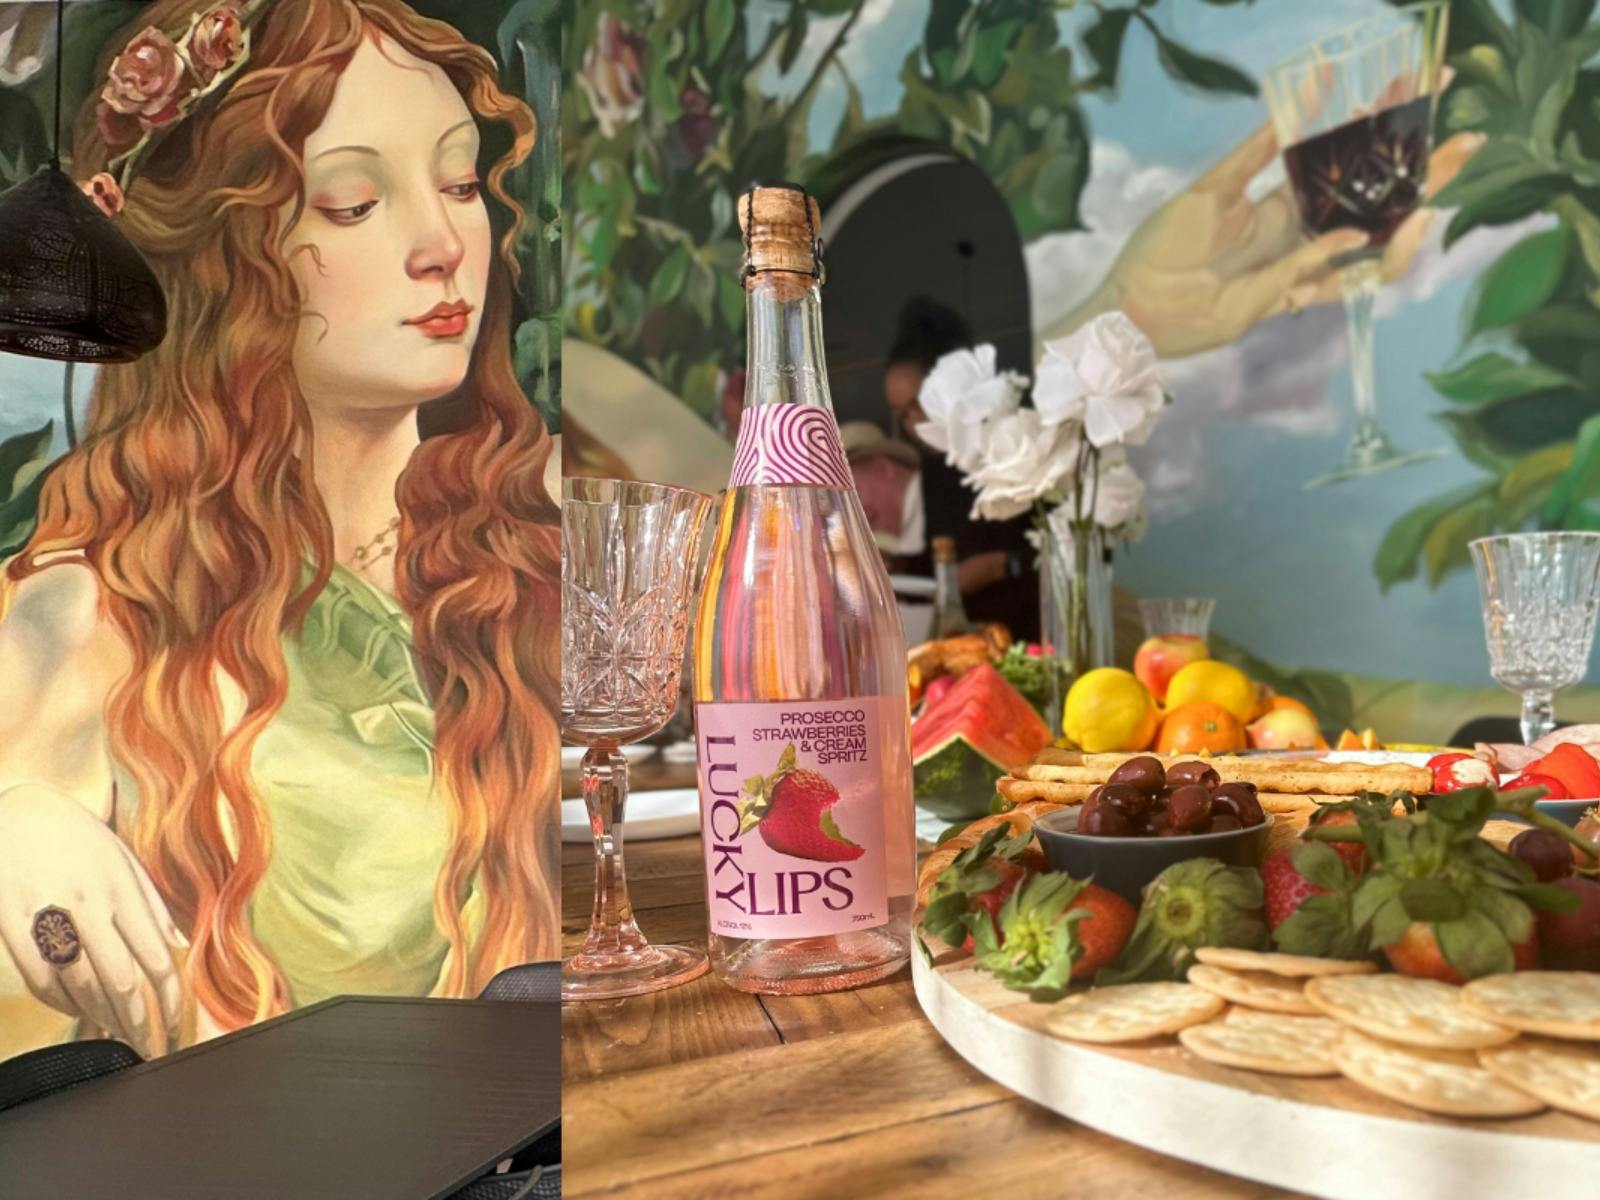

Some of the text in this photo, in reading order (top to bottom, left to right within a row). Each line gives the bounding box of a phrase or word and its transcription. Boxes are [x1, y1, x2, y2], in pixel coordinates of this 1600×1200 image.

[780, 709, 865, 725] PROSECCO
[752, 724, 866, 742] STRAWBERRIES
[800, 737, 867, 753] & CREAM
[817, 749, 868, 765] SPRITZ
[706, 735, 747, 914] LUCKY
[747, 866, 854, 916] LIPS
